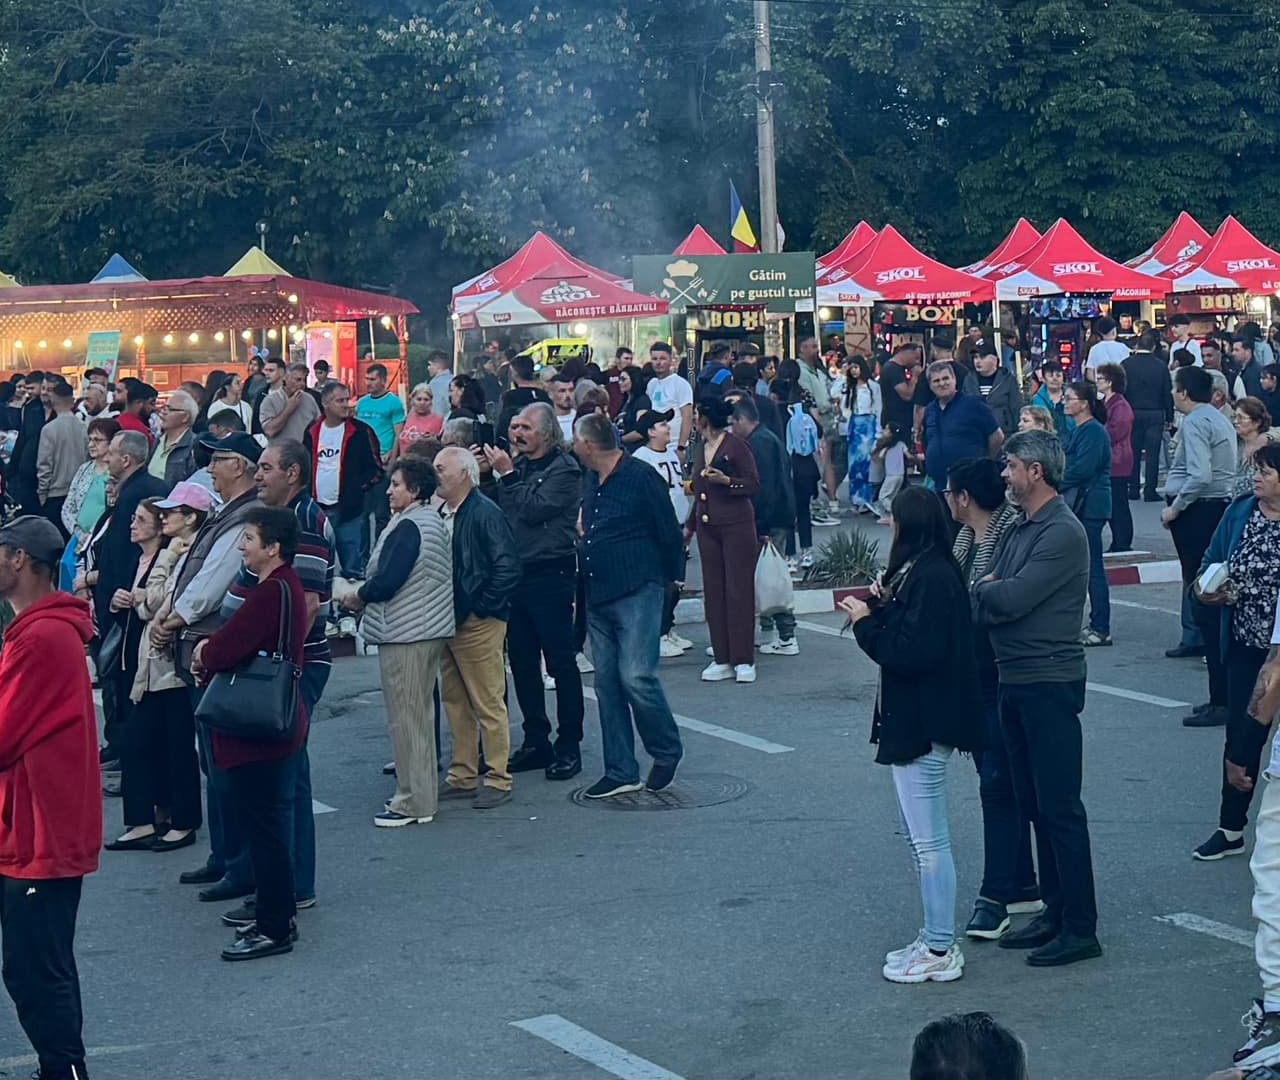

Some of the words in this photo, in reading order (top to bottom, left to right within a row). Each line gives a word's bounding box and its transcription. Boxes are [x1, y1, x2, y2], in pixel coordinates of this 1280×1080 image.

[1053, 262, 1102, 274] SKOL
[1227, 260, 1276, 272] SKOL
[876, 268, 925, 283] SKOL
[540, 289, 600, 304] SKOL
[730, 290, 745, 301] pe
[748, 286, 786, 301] gustul
[658, 461, 684, 488] 75
